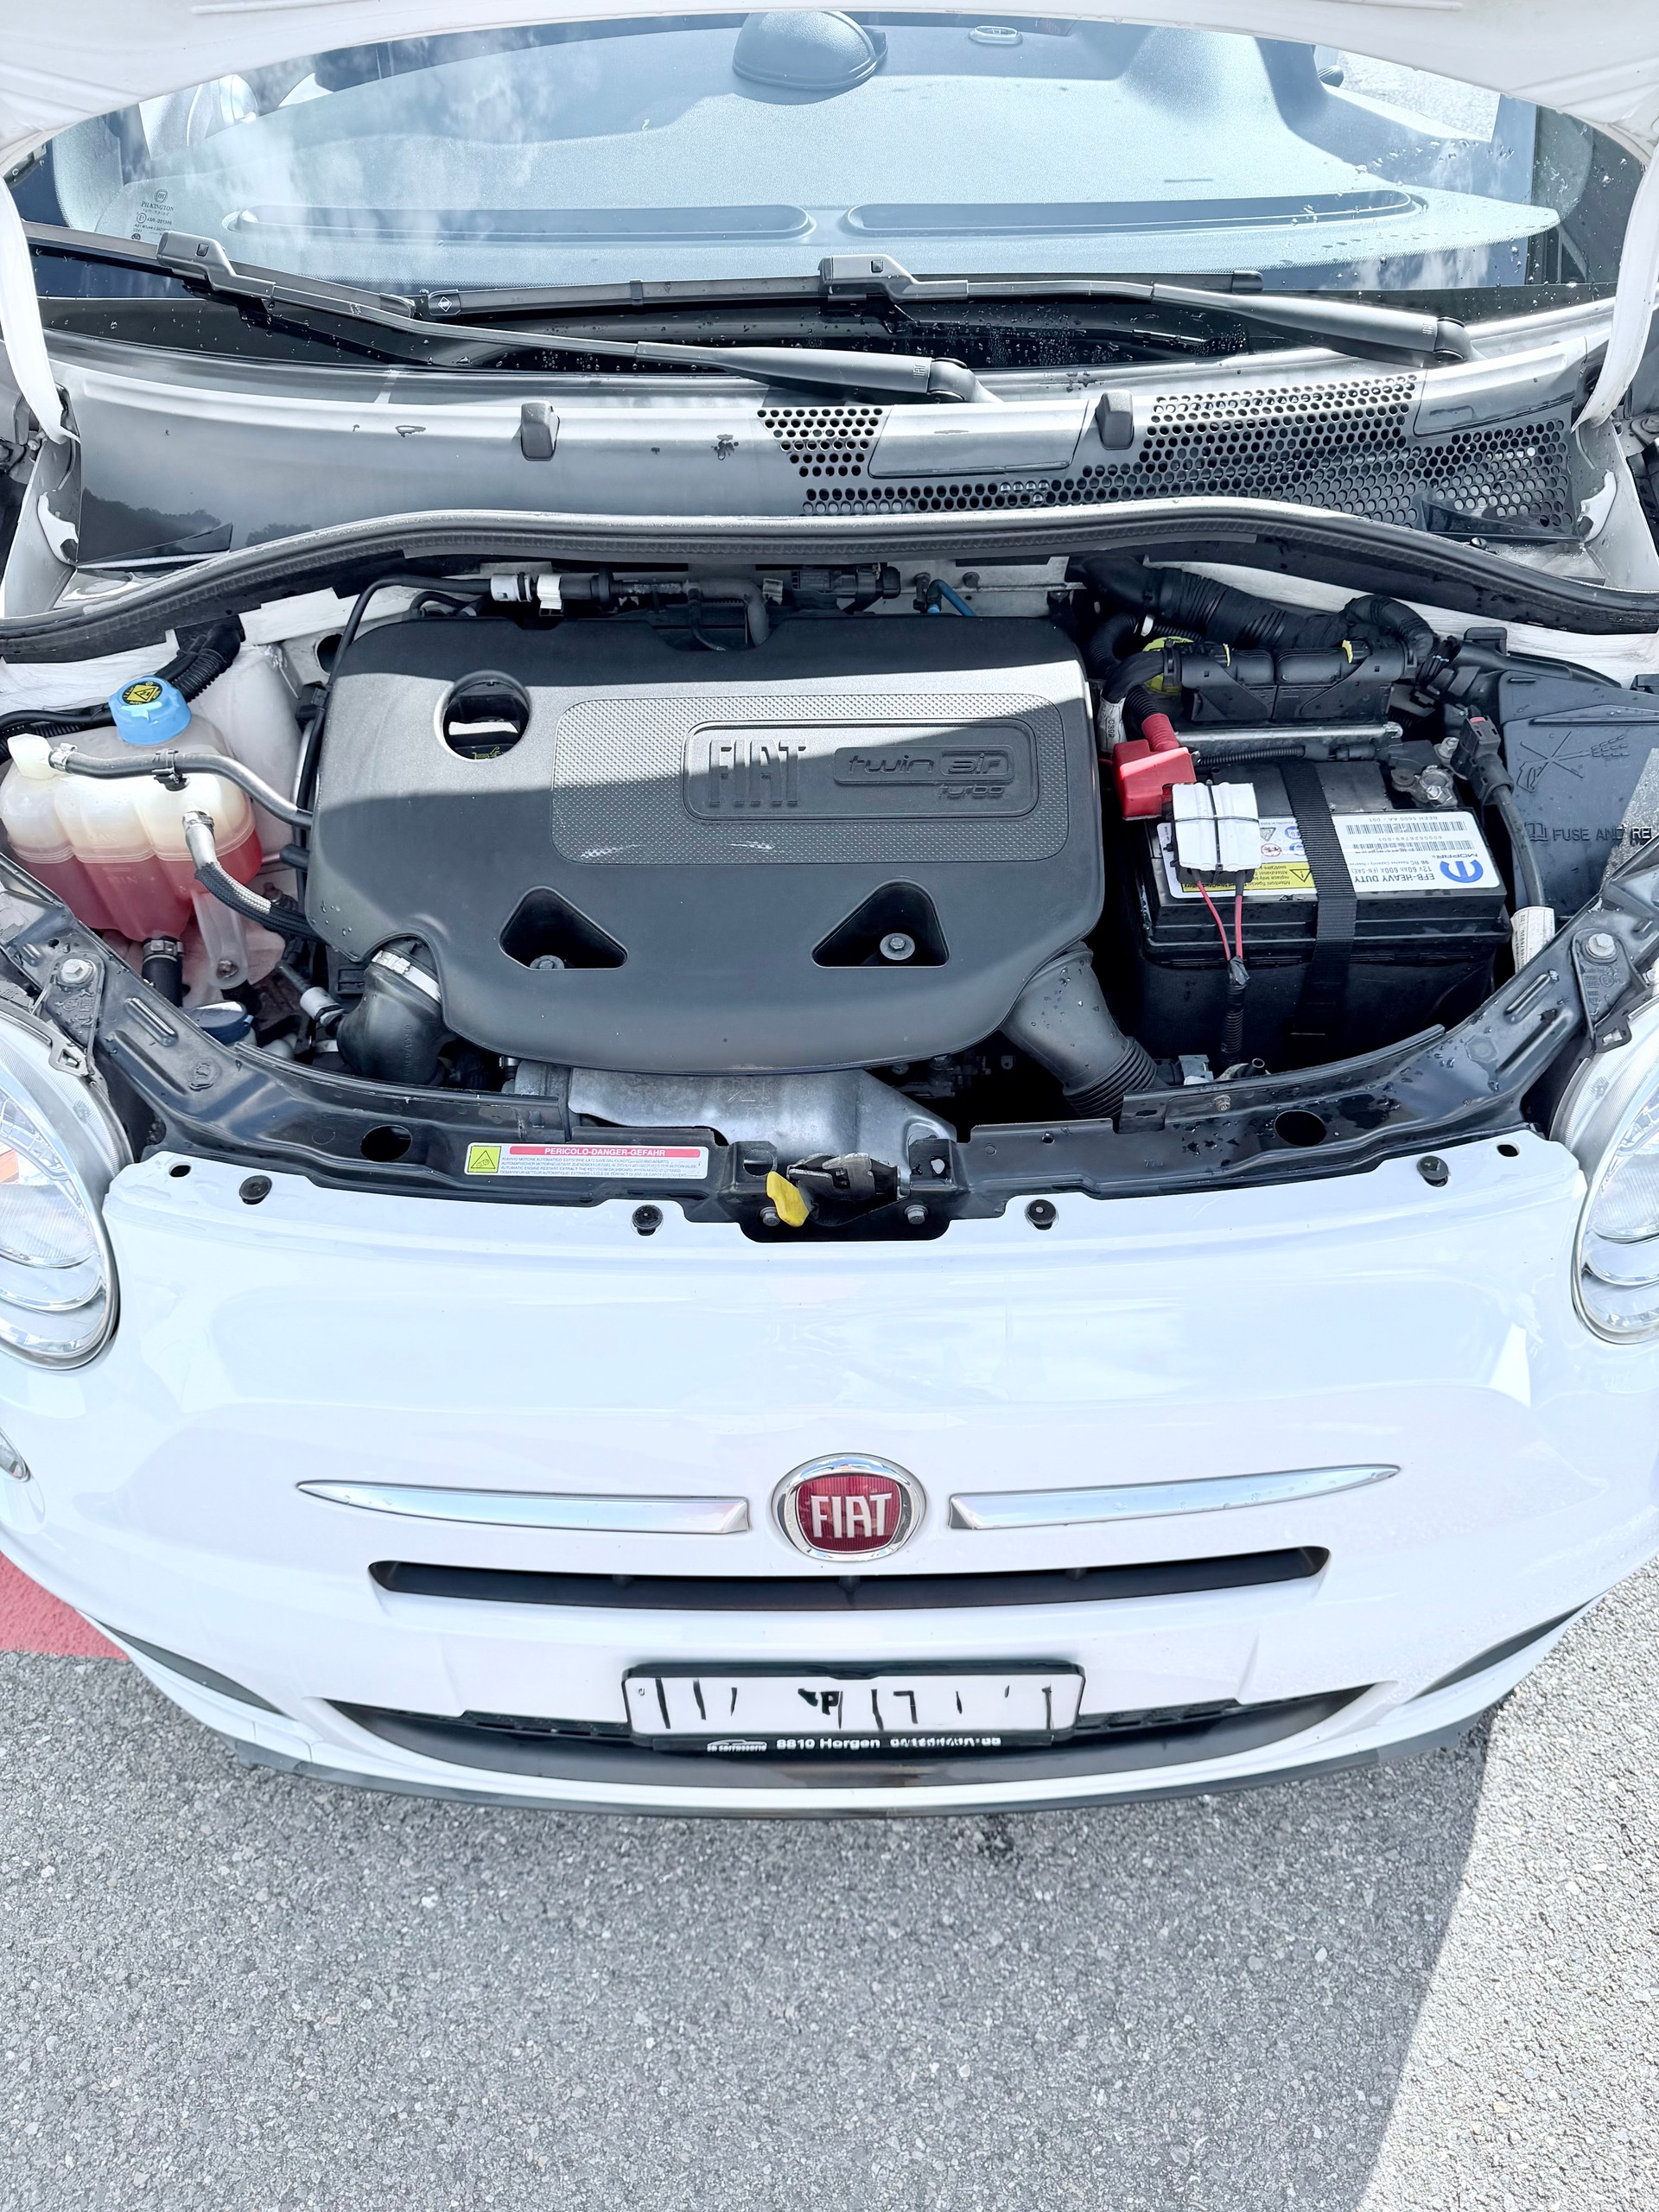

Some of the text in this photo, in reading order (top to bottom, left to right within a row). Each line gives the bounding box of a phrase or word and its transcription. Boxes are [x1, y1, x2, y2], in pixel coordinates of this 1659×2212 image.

[709, 738, 807, 807] FIAT
[938, 782, 1006, 798] turbo
[1553, 827, 1591, 842] FUSE
[1595, 825, 1626, 842] AND
[1353, 874, 1378, 883] DUTY
[544, 1147, 665, 1156] PERICOLO-DANGER-GEFAHR
[810, 1491, 893, 1539] FIAT
[776, 1738, 816, 1750] 8810
[819, 1737, 881, 1751] Horgen
